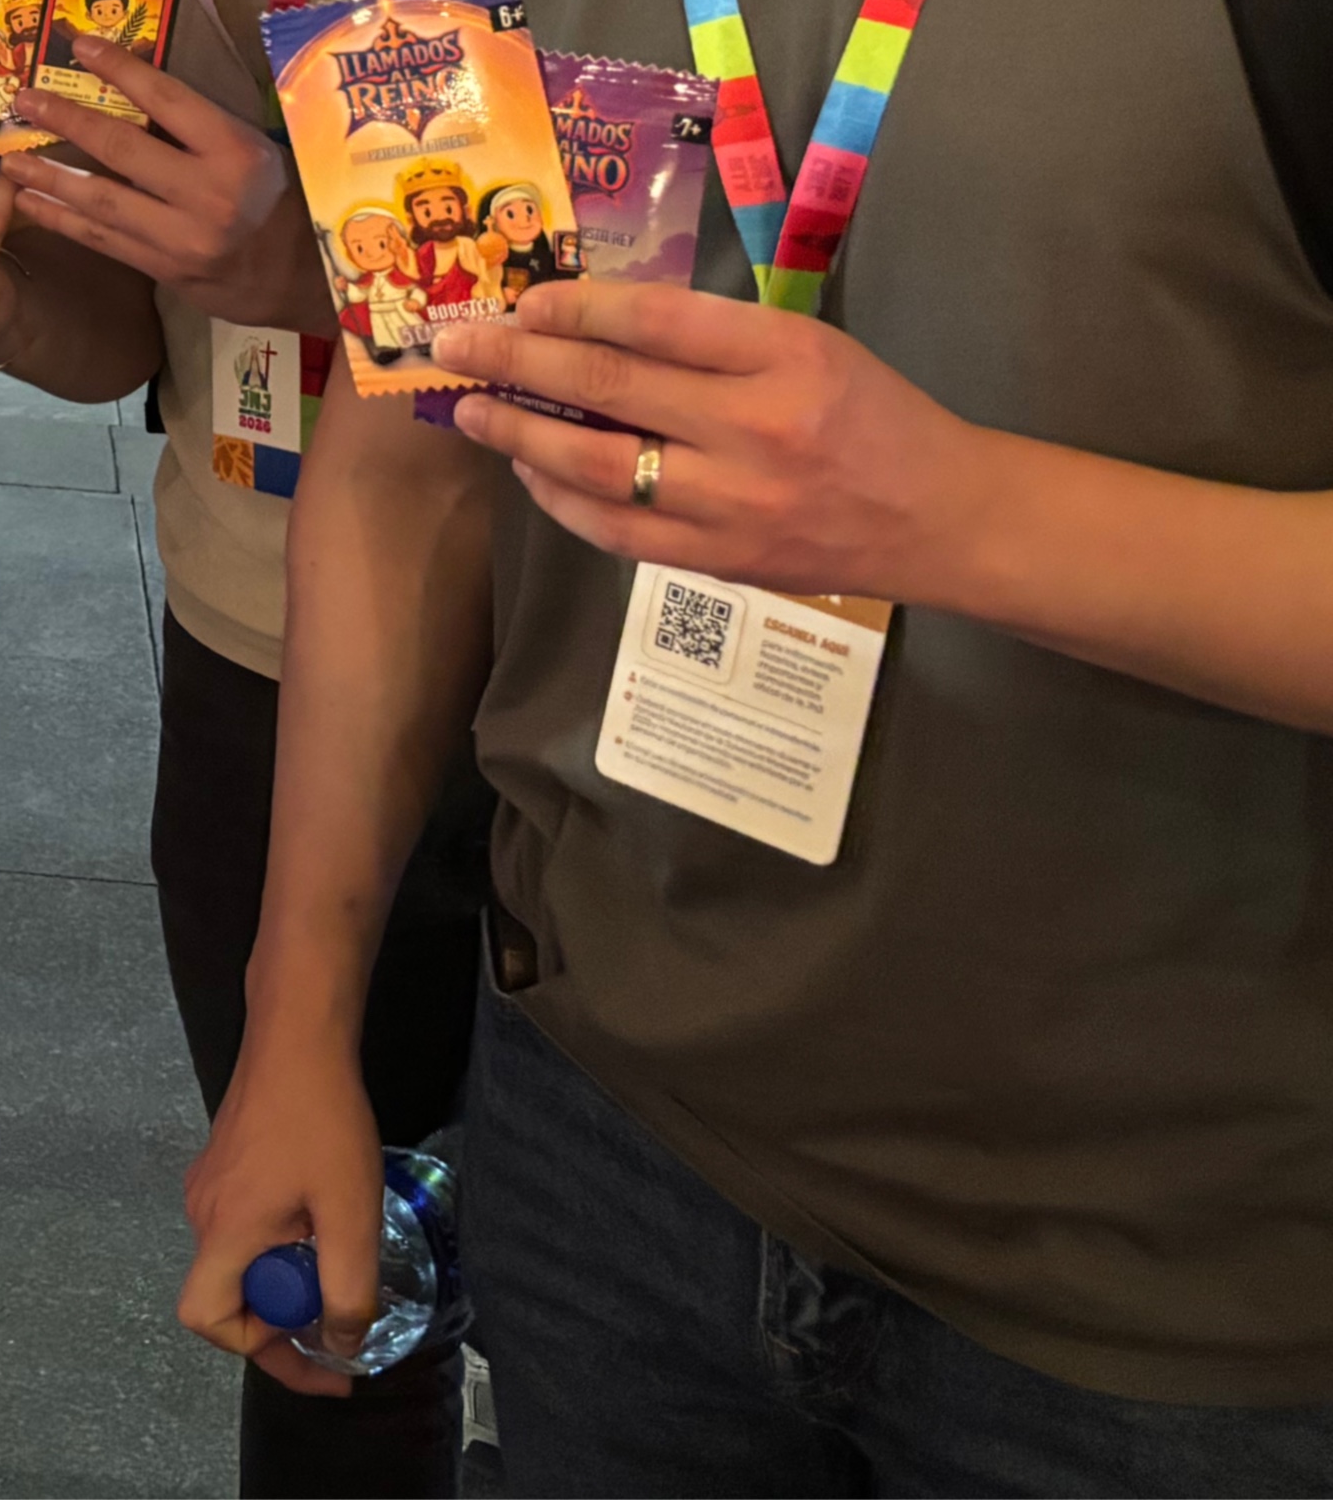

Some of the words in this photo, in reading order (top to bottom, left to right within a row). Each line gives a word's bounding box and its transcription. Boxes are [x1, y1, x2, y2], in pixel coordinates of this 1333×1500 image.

[499, 3, 523, 28] 6+
[337, 30, 461, 82] LLAMADOS
[391, 67, 418, 84] AL
[557, 117, 632, 152] MADOS
[679, 118, 702, 136] 7+
[562, 153, 628, 192] INO
[427, 297, 500, 322] BOOSTER
[238, 415, 272, 434] 2026
